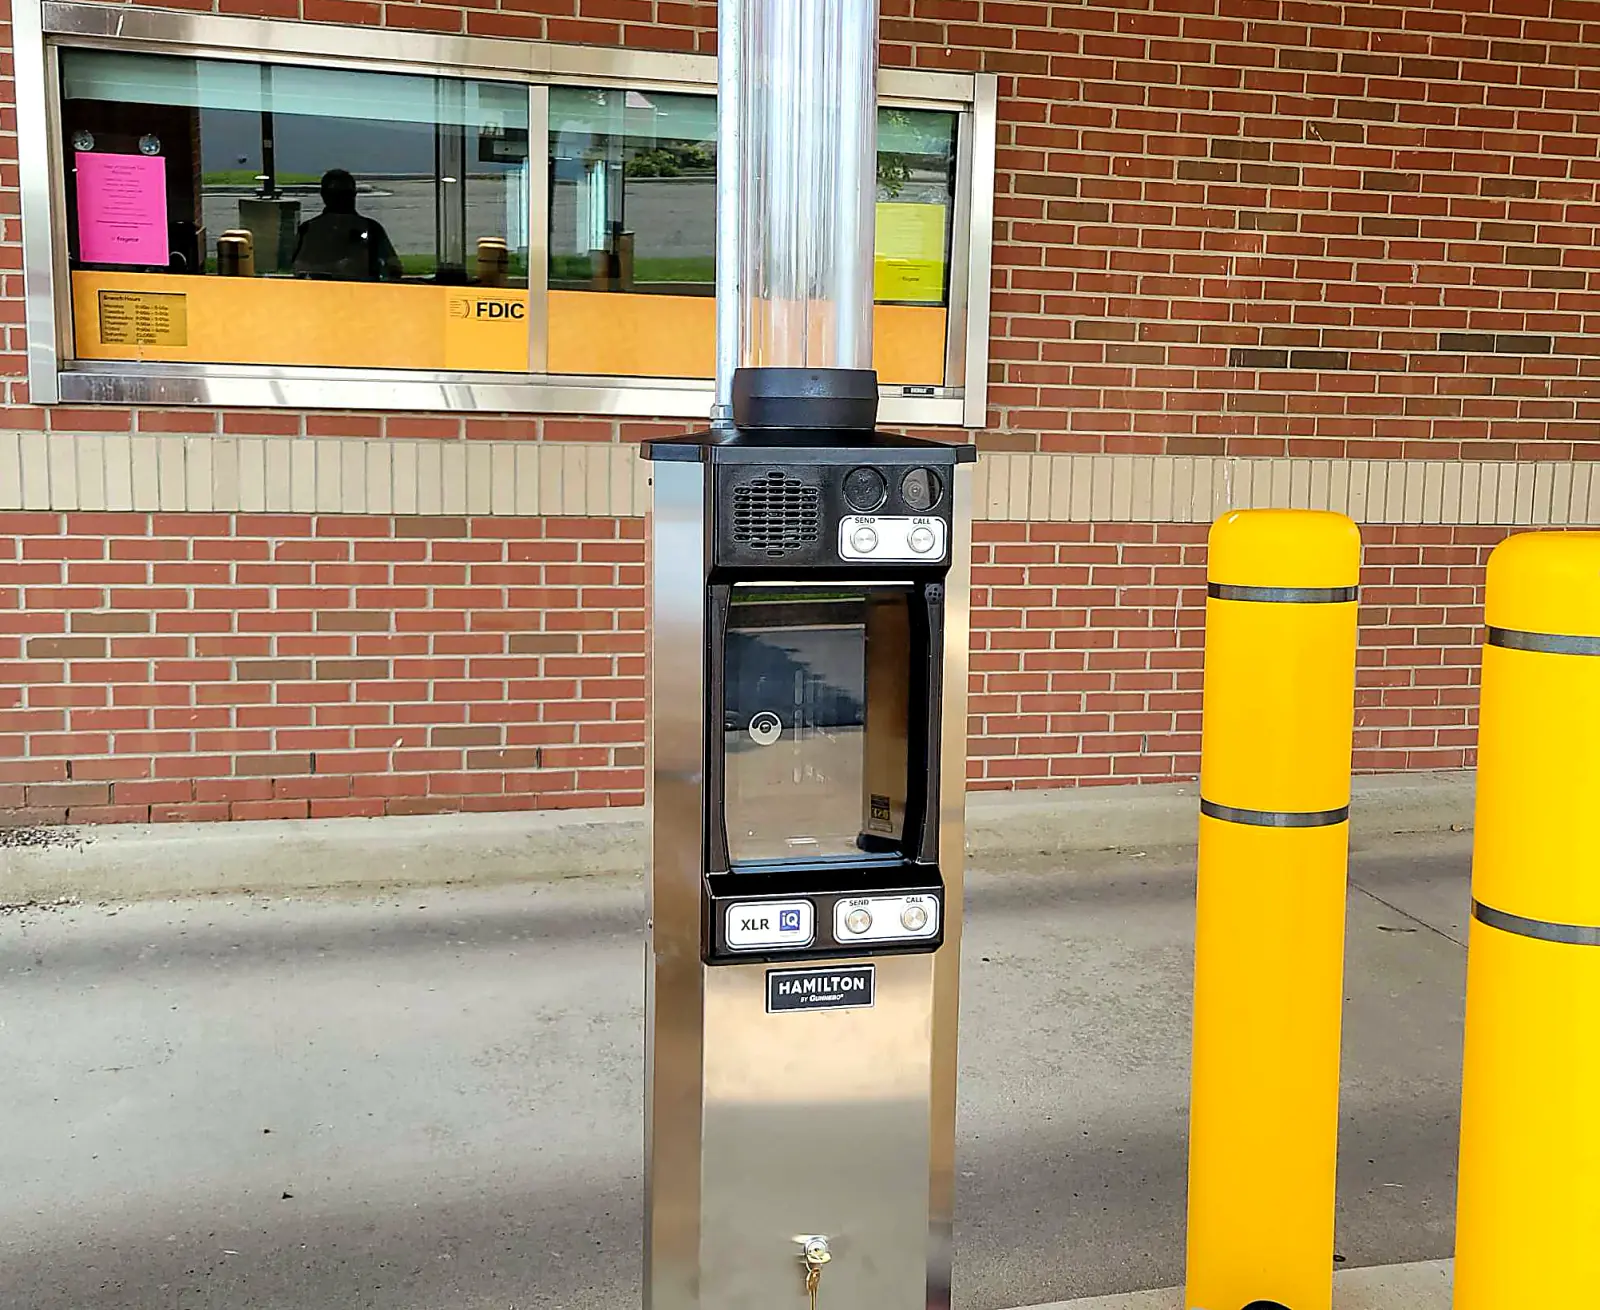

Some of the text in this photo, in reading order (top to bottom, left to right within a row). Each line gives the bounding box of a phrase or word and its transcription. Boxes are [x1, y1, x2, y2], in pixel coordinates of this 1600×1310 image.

[476, 301, 525, 319] FDIC
[912, 517, 931, 525] CALL
[848, 896, 924, 907] SEND CALL
[740, 918, 770, 931] XLR
[778, 976, 865, 995] HAMILTON
[800, 995, 809, 1003] BY
